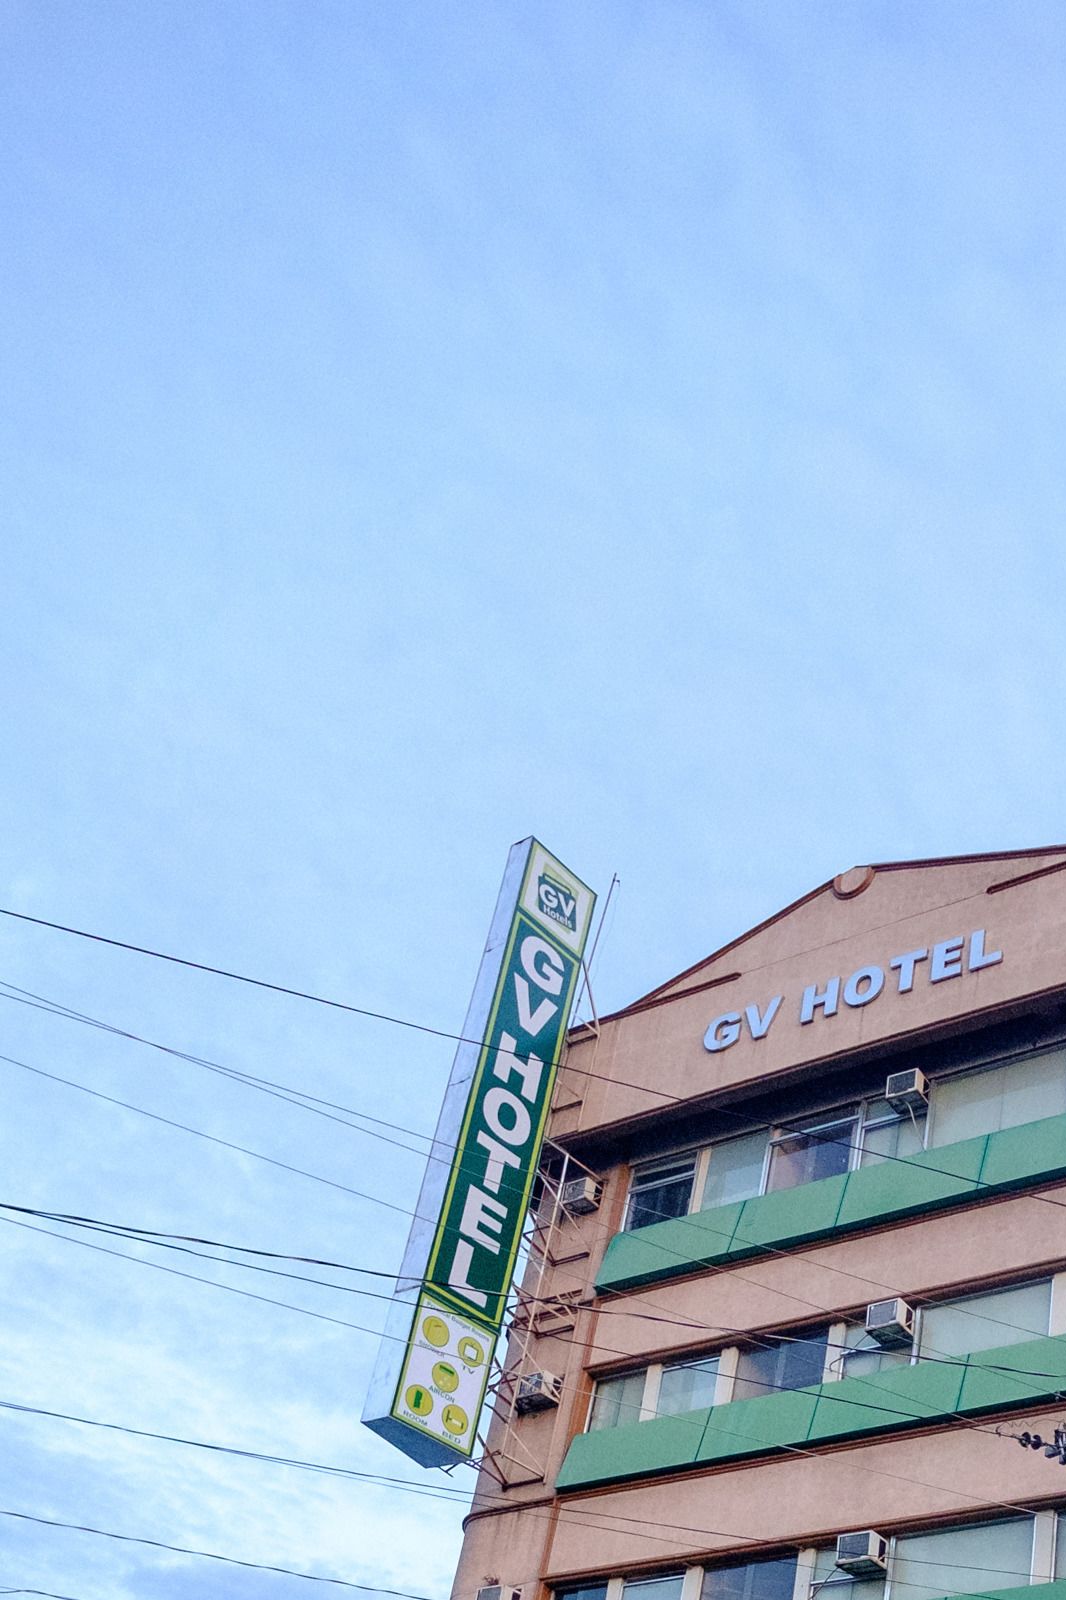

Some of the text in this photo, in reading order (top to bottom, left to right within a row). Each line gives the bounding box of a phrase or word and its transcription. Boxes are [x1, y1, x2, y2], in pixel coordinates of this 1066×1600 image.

[539, 884, 575, 918] GV
[543, 904, 573, 928] Hotels
[703, 929, 1003, 1053] GV HOTEL
[447, 935, 565, 1308] GV HOTEL
[462, 1365, 475, 1375] TV
[428, 1385, 456, 1403] AIRCON
[403, 1409, 428, 1427] ROOM
[442, 1430, 462, 1445] BED
